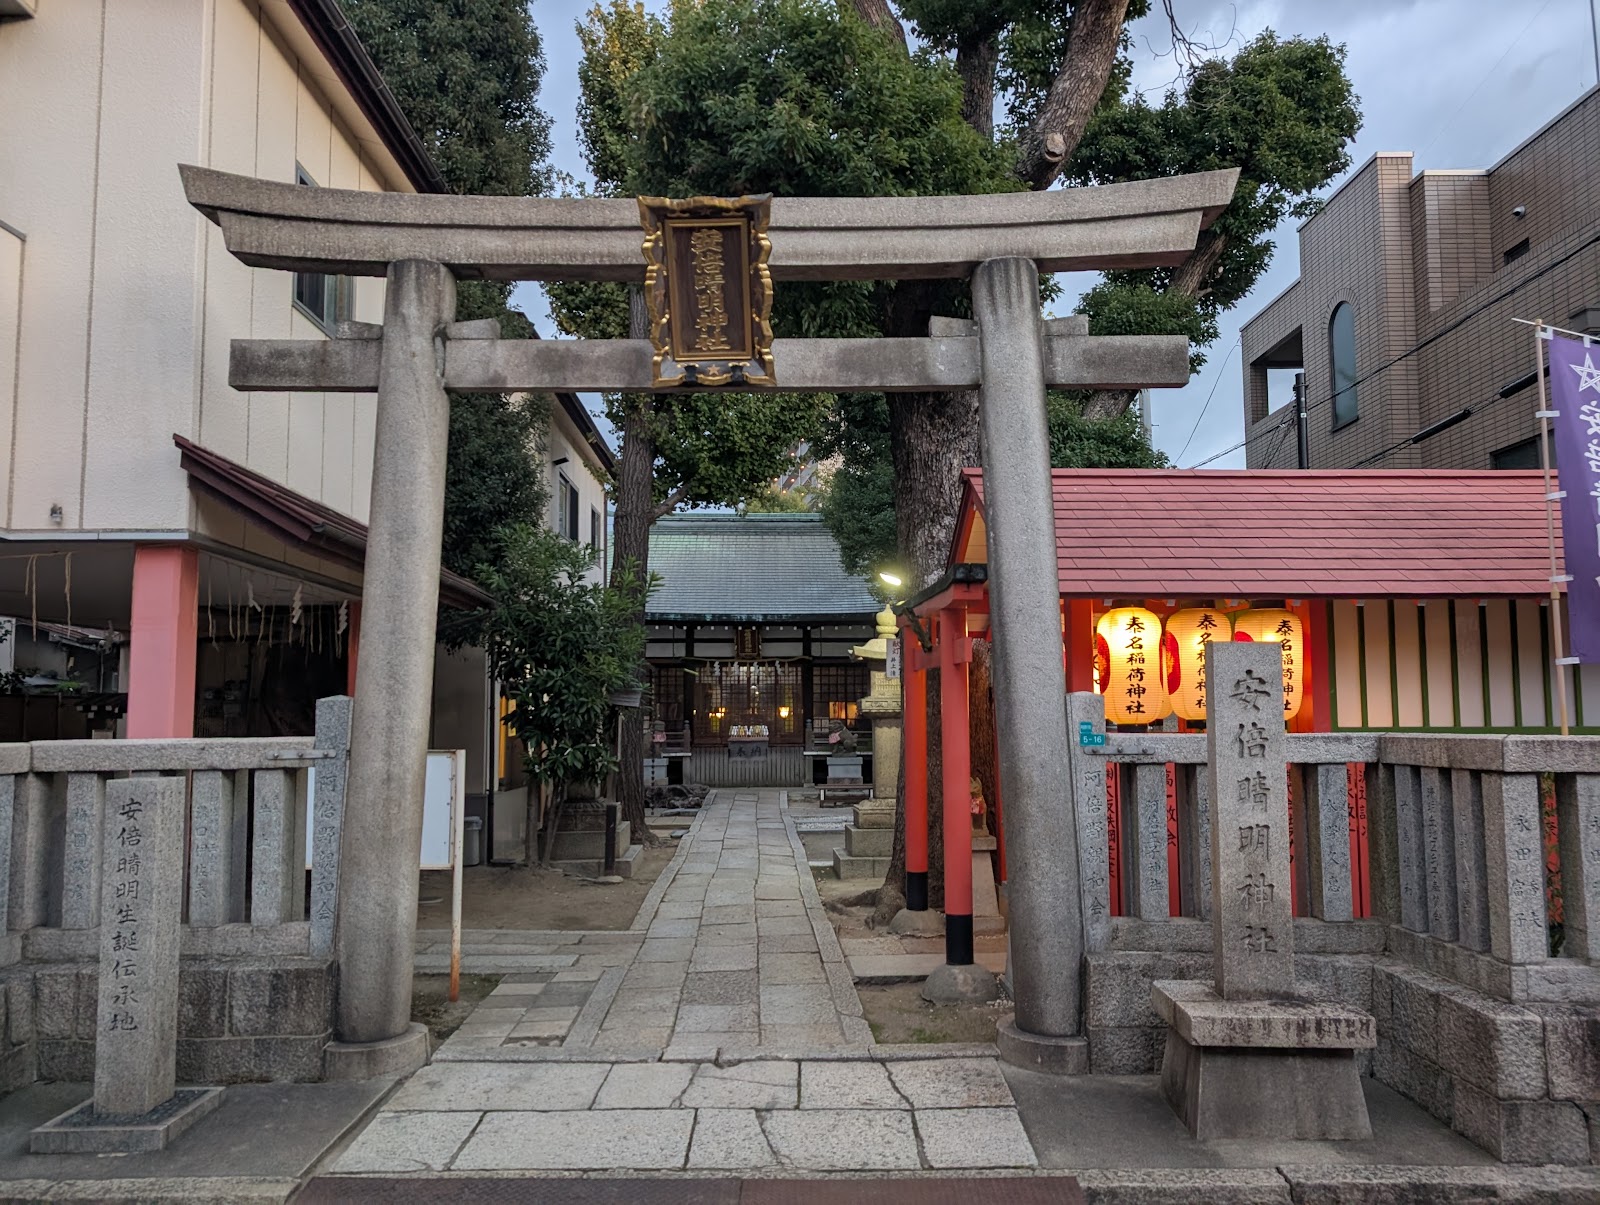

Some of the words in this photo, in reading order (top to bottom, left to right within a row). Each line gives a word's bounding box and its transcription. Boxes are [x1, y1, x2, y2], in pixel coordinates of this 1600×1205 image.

[691, 228, 731, 351] 安倍晴明神社
[1125, 616, 1146, 715] 泰名稲荷神社
[1083, 735, 1102, 744] 5-16
[1229, 669, 1277, 954] 安倍晴明神社
[109, 797, 143, 1032] 安倍晴明生誕伝承地
